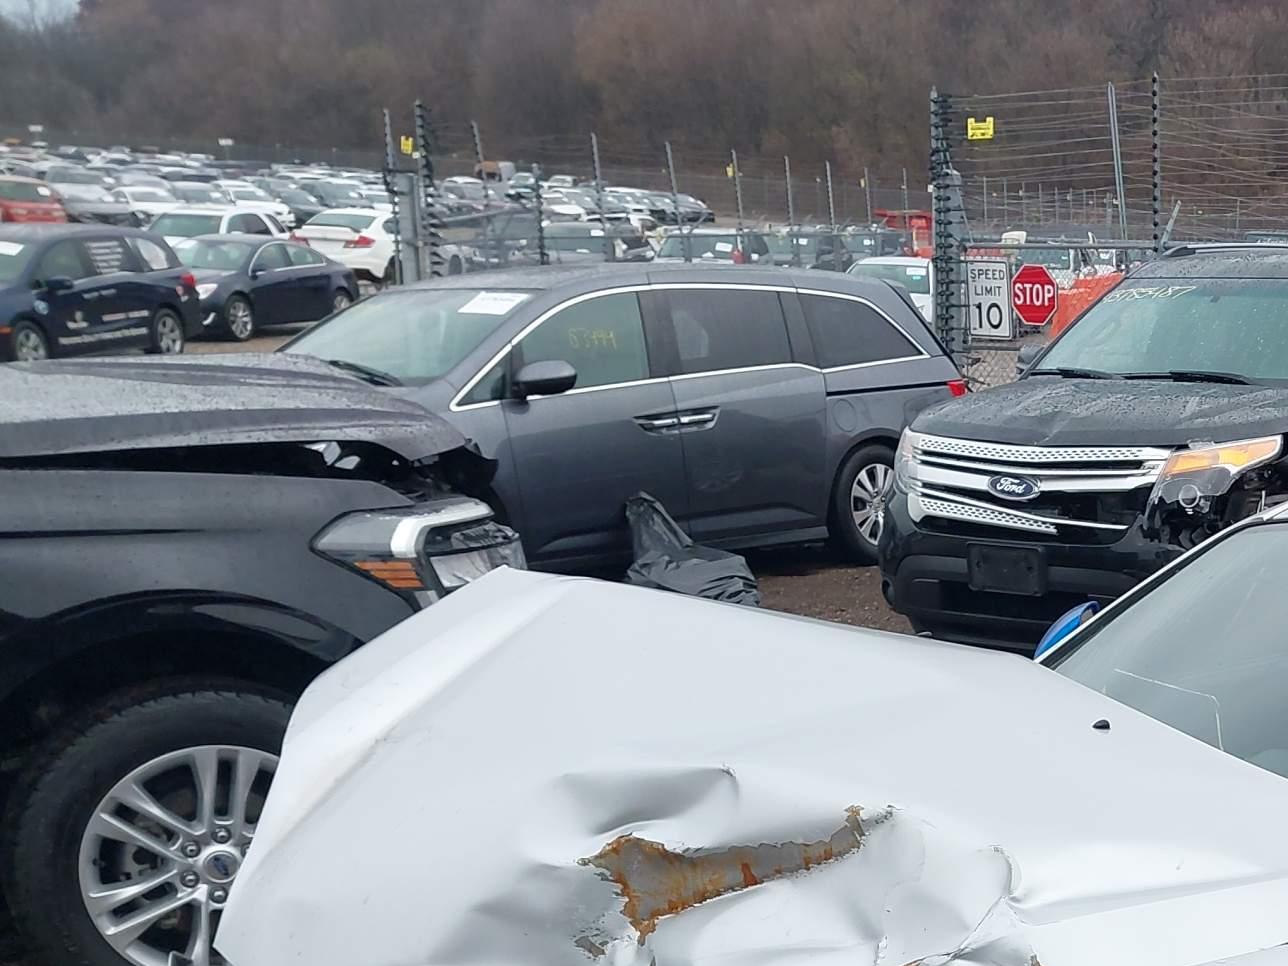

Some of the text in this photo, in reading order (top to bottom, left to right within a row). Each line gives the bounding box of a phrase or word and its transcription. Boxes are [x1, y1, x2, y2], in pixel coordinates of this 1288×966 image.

[970, 268, 1005, 280] SPEED
[974, 284, 1003, 297] LIMIT
[1014, 283, 1054, 306] STOP
[974, 302, 1003, 330] 10
[995, 476, 1028, 494] Ford
